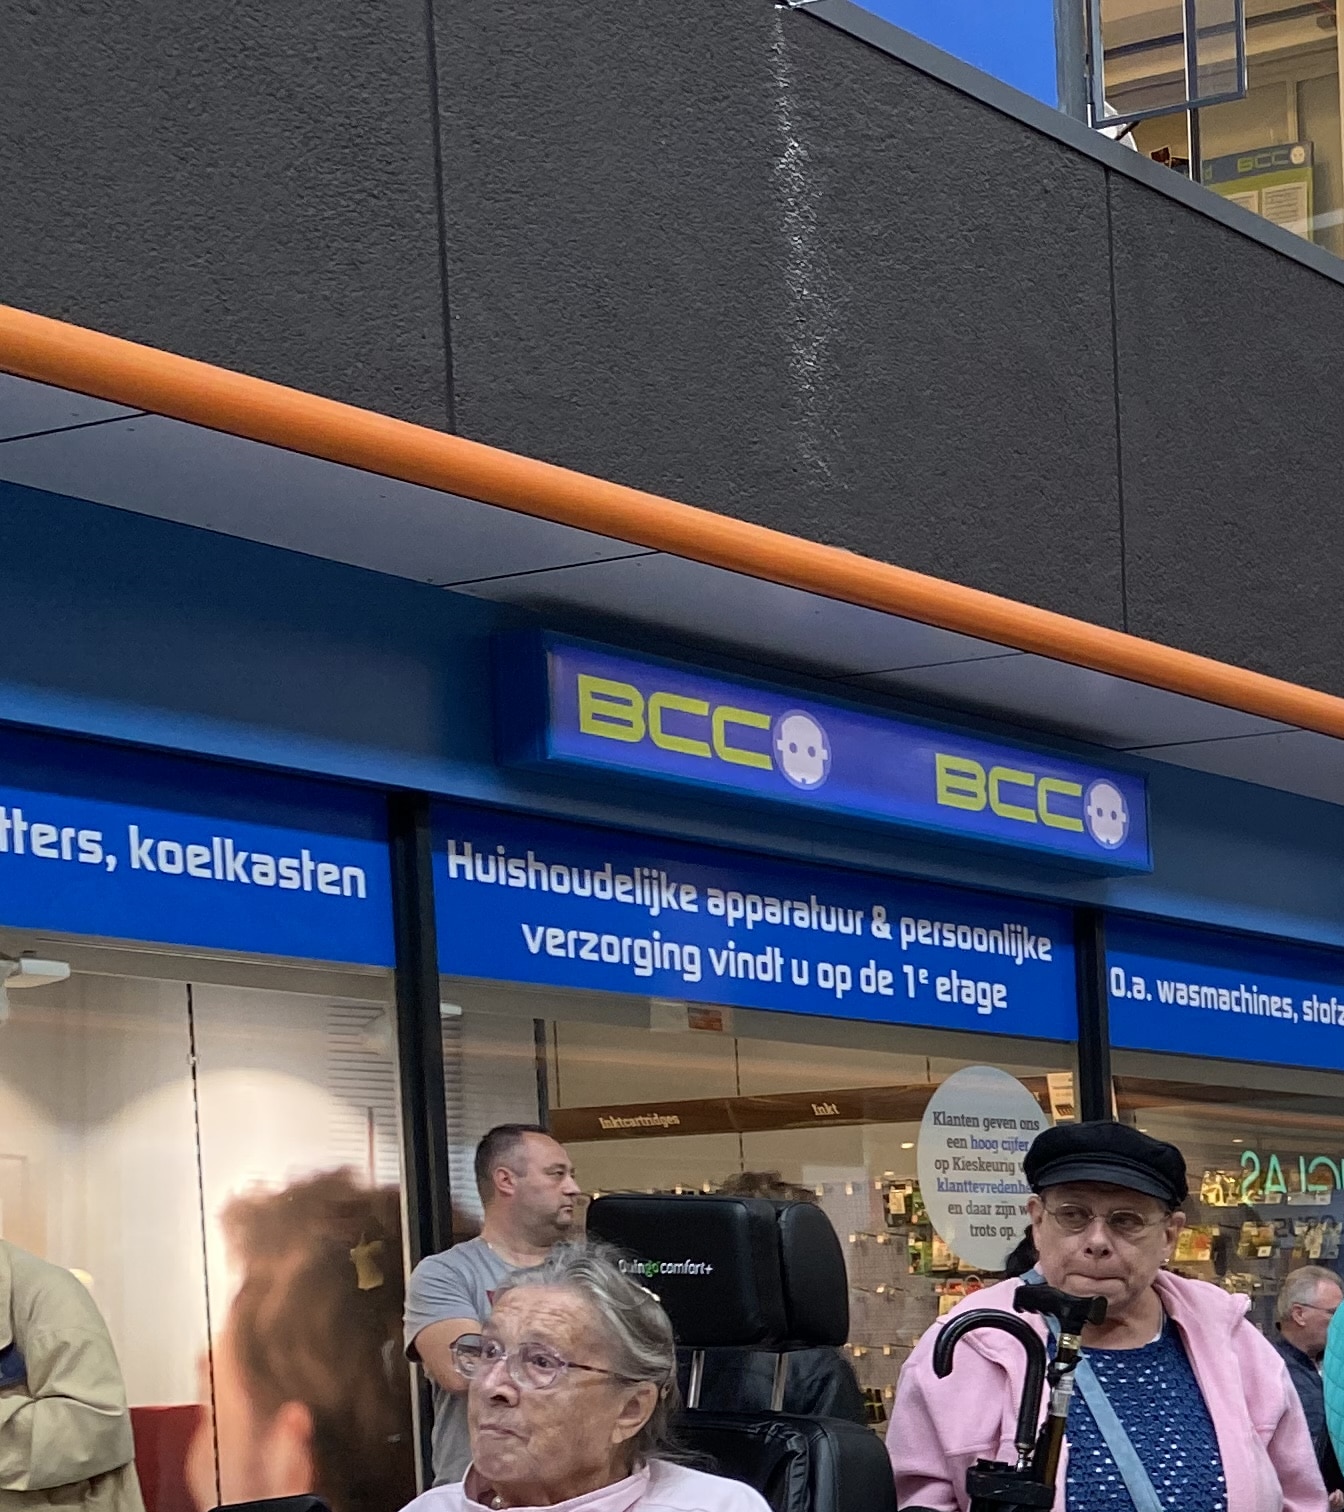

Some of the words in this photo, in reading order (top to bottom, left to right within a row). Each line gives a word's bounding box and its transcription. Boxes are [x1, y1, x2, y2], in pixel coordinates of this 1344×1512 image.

[578, 674, 773, 770] BCC
[936, 753, 1084, 832] BCC
[129, 825, 366, 898] koelkasten
[447, 839, 699, 916] Huishoudelijke
[707, 887, 863, 936] apparatuur
[871, 905, 892, 940] &
[901, 916, 1052, 965] persoonlijke
[521, 923, 701, 982] verzorging
[708, 940, 784, 983] vindt
[791, 957, 809, 986] u
[817, 961, 852, 999] op
[859, 959, 894, 996] de
[936, 970, 1008, 1015] etage
[1110, 967, 1152, 1002] O.a.
[1157, 979, 1298, 1024] wasmachines,
[811, 1102, 840, 1116] Inkt
[598, 1112, 680, 1129] Inktcartridges
[933, 1111, 980, 1128] Klanten
[983, 1117, 1017, 1131] geven
[1020, 1119, 1040, 1130] ons
[947, 1136, 967, 1149] een
[970, 1135, 998, 1154] hoog
[934, 1159, 949, 1174] op
[952, 1156, 1015, 1176] Kieskeurig
[937, 1178, 1032, 1193] klanttevredenhe
[948, 1203, 962, 1214] en
[966, 1200, 991, 1215] daar
[995, 1201, 1016, 1219] zijn
[970, 1223, 997, 1237] trots
[1000, 1225, 1016, 1240] op.
